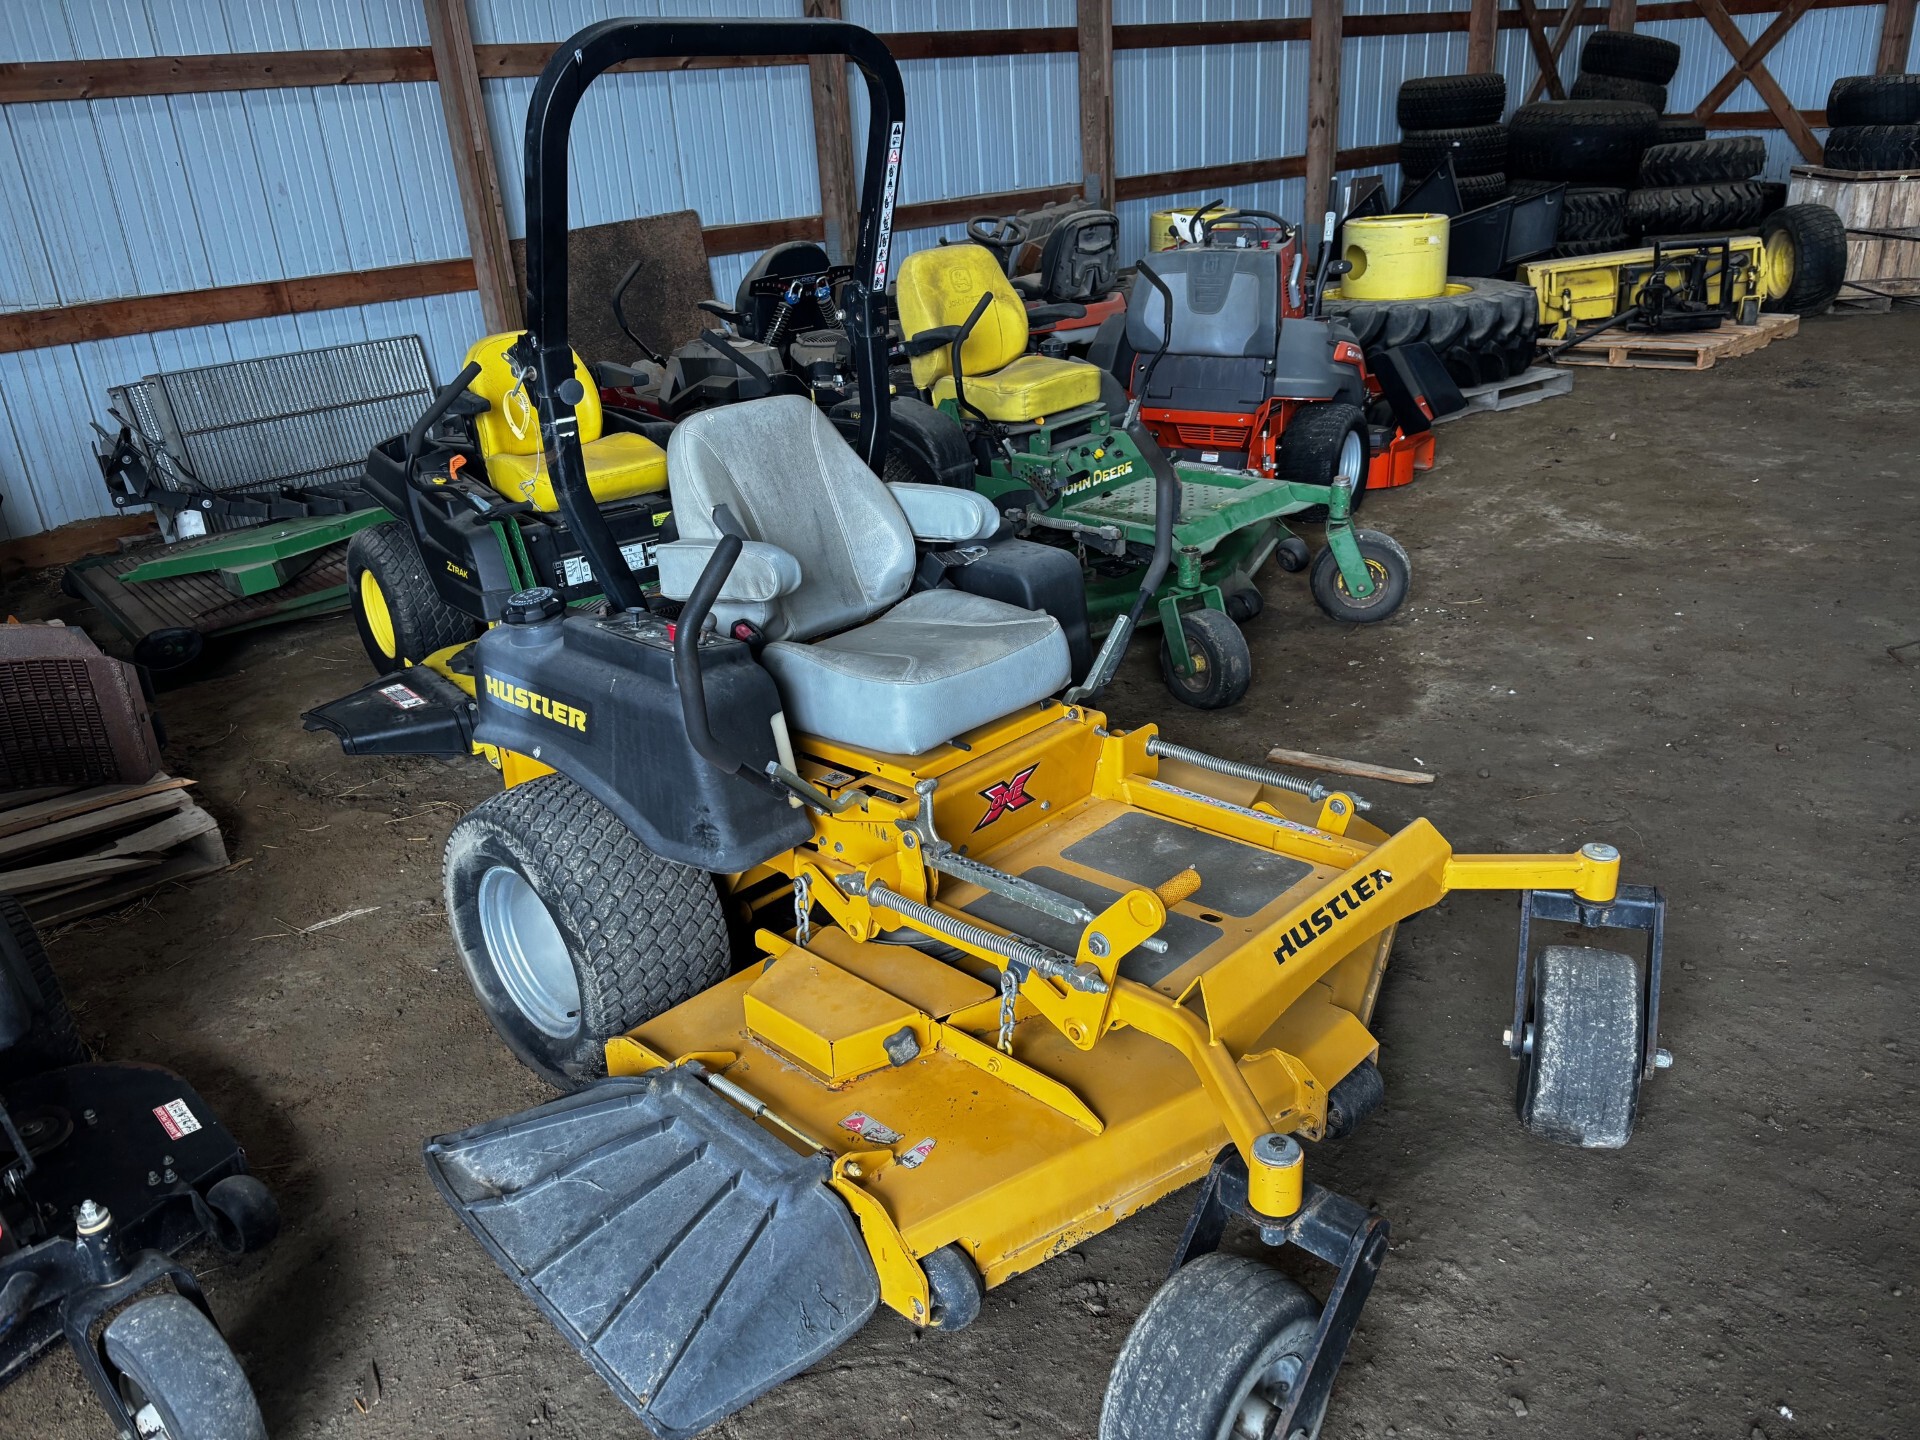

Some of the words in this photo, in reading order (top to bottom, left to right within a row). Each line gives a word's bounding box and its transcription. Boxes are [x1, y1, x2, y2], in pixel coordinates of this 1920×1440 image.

[1092, 461, 1133, 487] DEERE
[446, 560, 469, 580] ZTRAK
[484, 673, 587, 733] HUSTLER
[991, 782, 1025, 811] ONE
